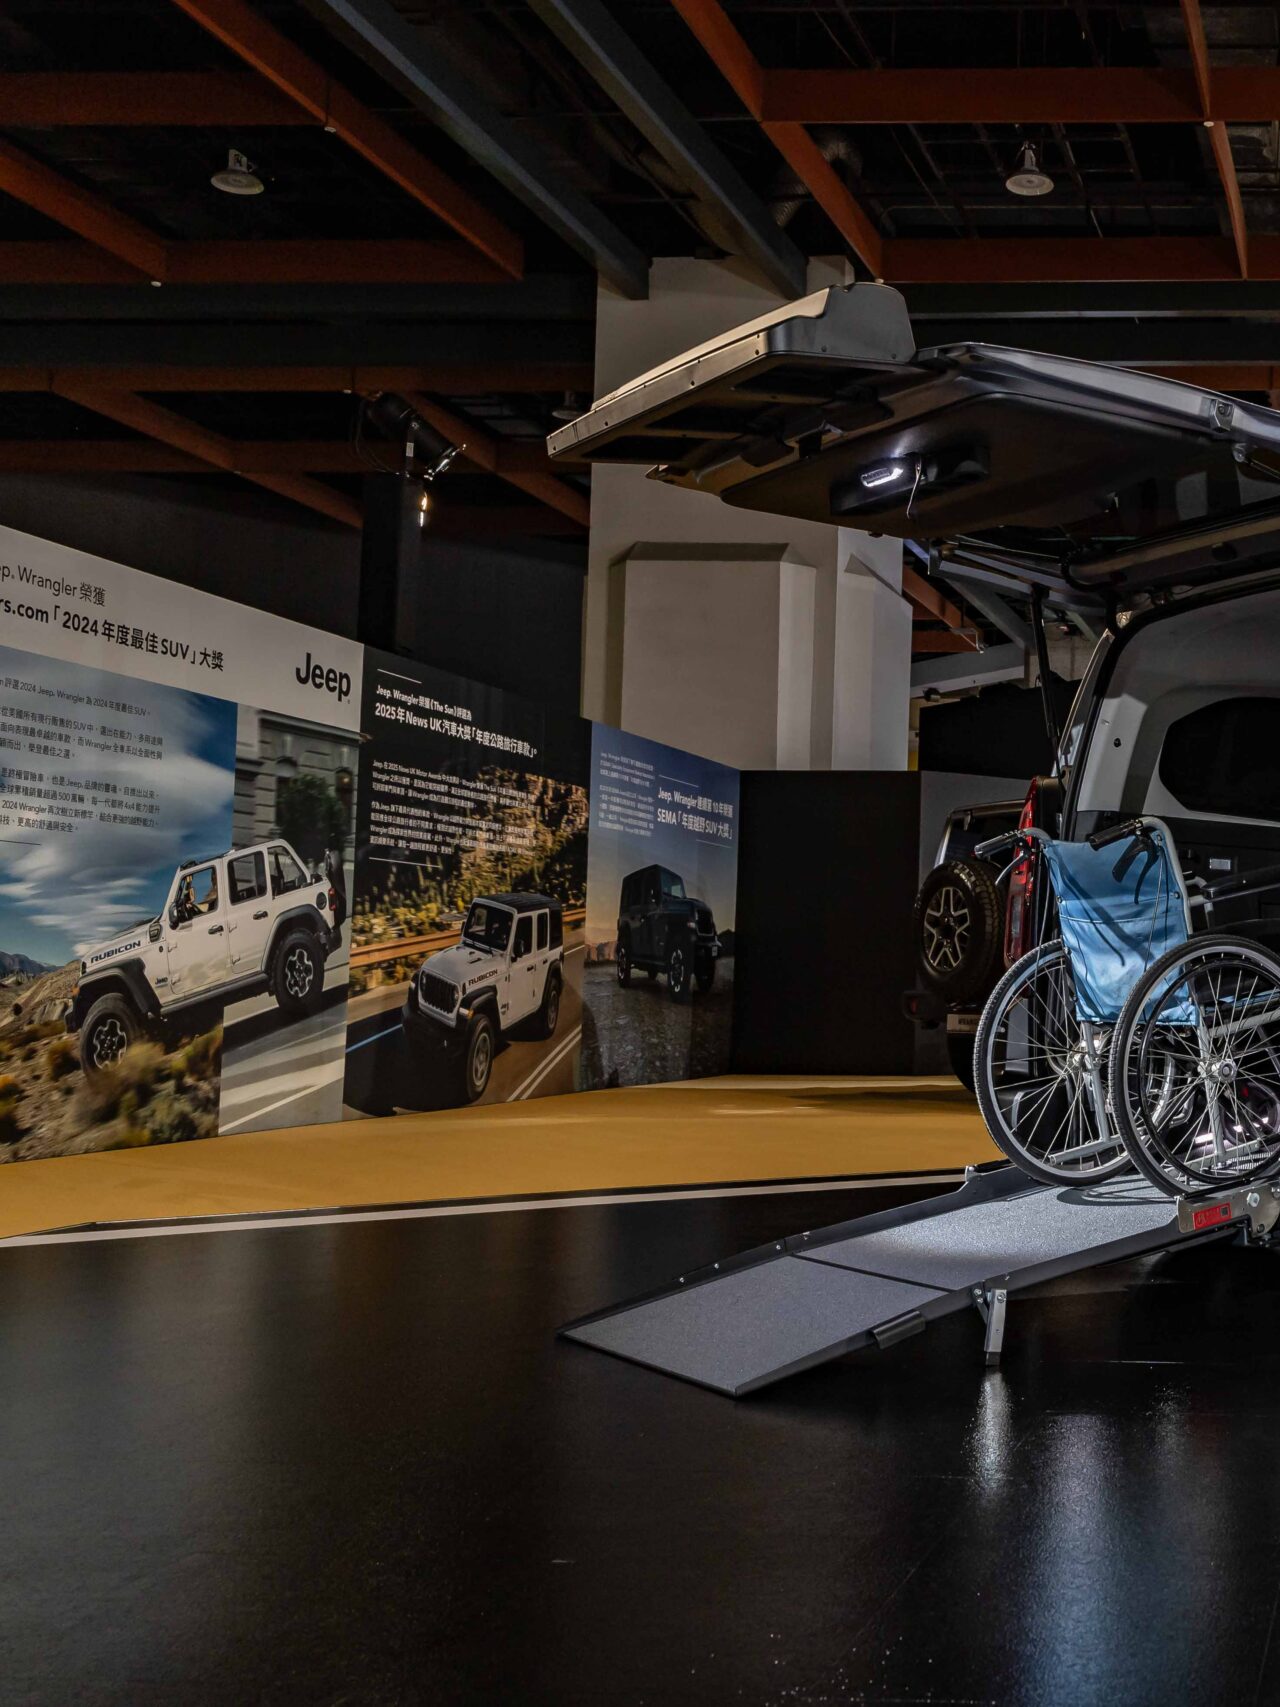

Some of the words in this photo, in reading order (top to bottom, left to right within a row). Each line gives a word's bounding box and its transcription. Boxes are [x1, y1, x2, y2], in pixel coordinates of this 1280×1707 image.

[18, 565, 77, 596] Wrangler
[80, 582, 106, 607] 榮獲
[296, 652, 351, 702] Jeep
[57, 689, 85, 704] Wrangler
[393, 689, 419, 706] Wrangler
[405, 711, 428, 729] News
[19, 802, 47, 815] Wrangler
[657, 808, 677, 825] SEMA
[91, 940, 142, 964] RUBICON
[468, 969, 498, 986] RUBICON
